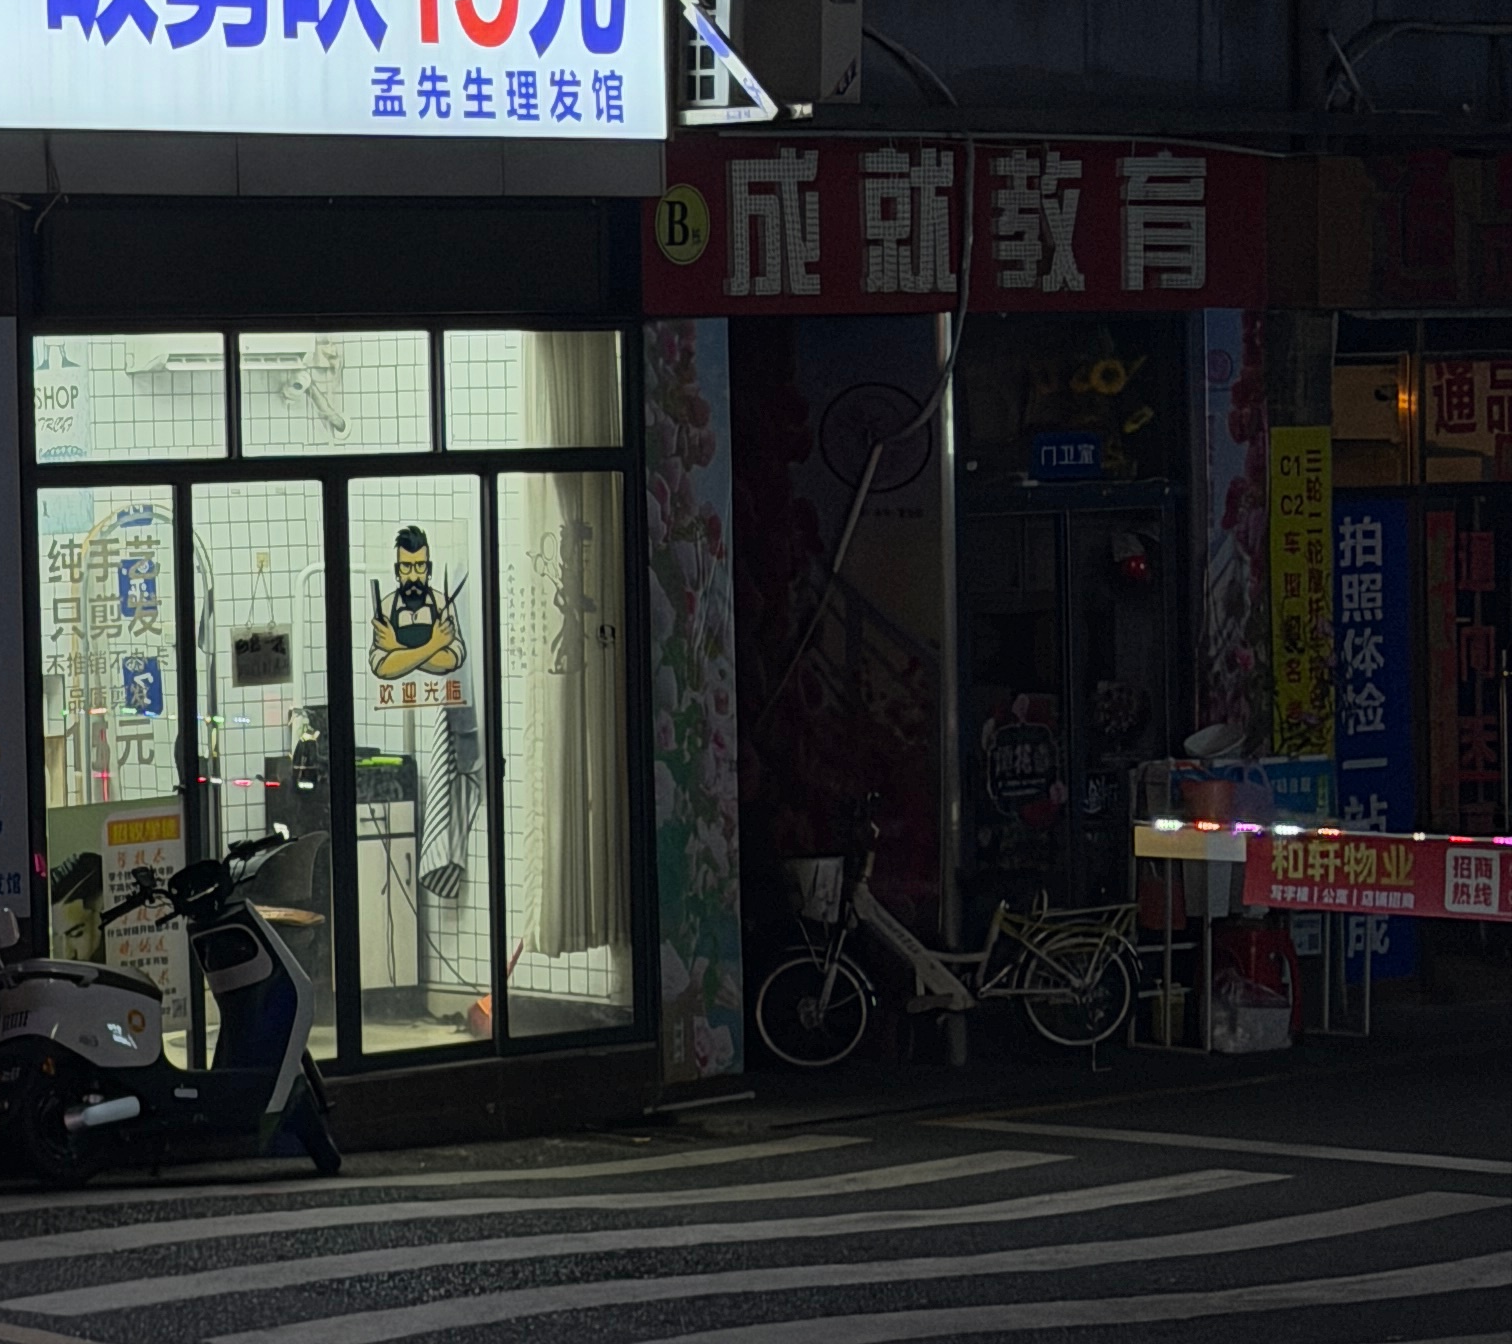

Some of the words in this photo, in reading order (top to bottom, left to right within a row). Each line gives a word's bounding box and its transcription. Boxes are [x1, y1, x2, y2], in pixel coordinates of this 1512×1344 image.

[371, 67, 627, 124] 孟先生理发馆
[723, 147, 1207, 296] 成就教育
[1281, 456, 1301, 476] C1
[1281, 494, 1304, 515] C2
[48, 535, 161, 583] 纯手艺
[50, 594, 163, 641] 只剪发
[379, 680, 462, 704] 欢迎光临
[1338, 515, 1389, 959] 拍照体检一站成
